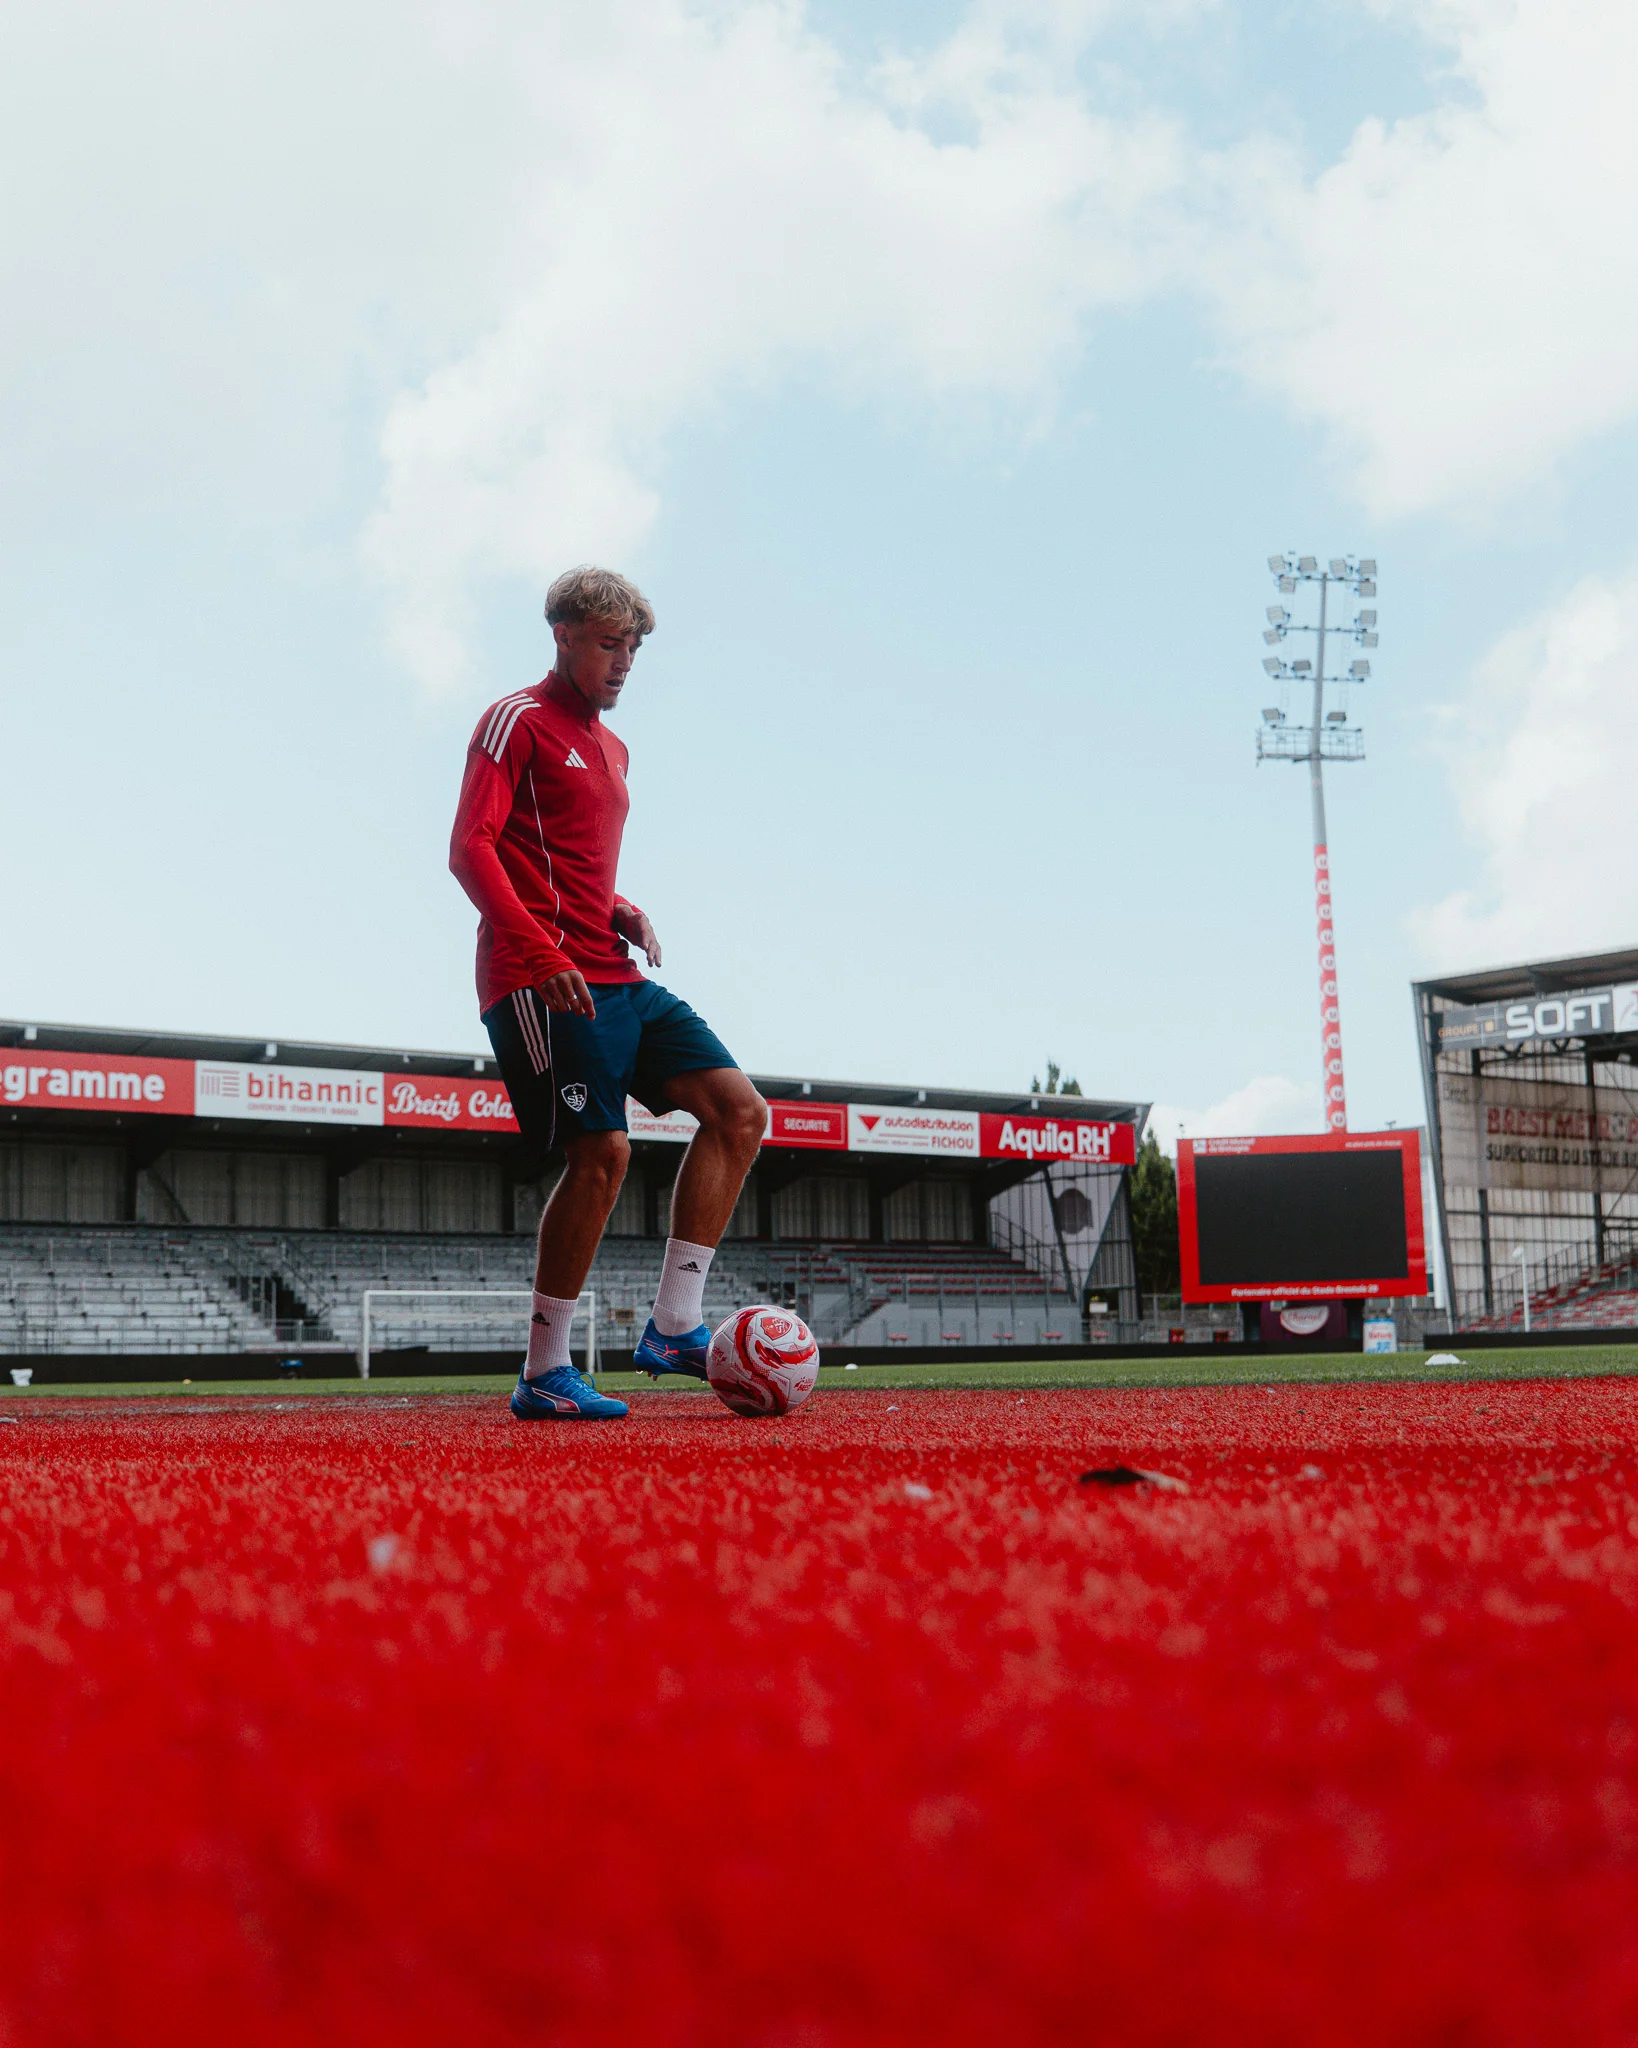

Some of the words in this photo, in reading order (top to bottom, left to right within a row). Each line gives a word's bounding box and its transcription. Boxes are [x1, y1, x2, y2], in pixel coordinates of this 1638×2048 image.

[1506, 994, 1610, 1040] SOFT
[0, 1065, 166, 1102] gramme
[247, 1072, 378, 1105] bihannic
[388, 1082, 461, 1121] Breizh
[468, 1090, 514, 1119] Cola
[631, 1122, 698, 1135] CONSTRUCTIO
[784, 1117, 831, 1132] SECURITE
[884, 1115, 974, 1131] autodistribution
[931, 1136, 974, 1149] FICHOU
[998, 1120, 1074, 1160] Aquila
